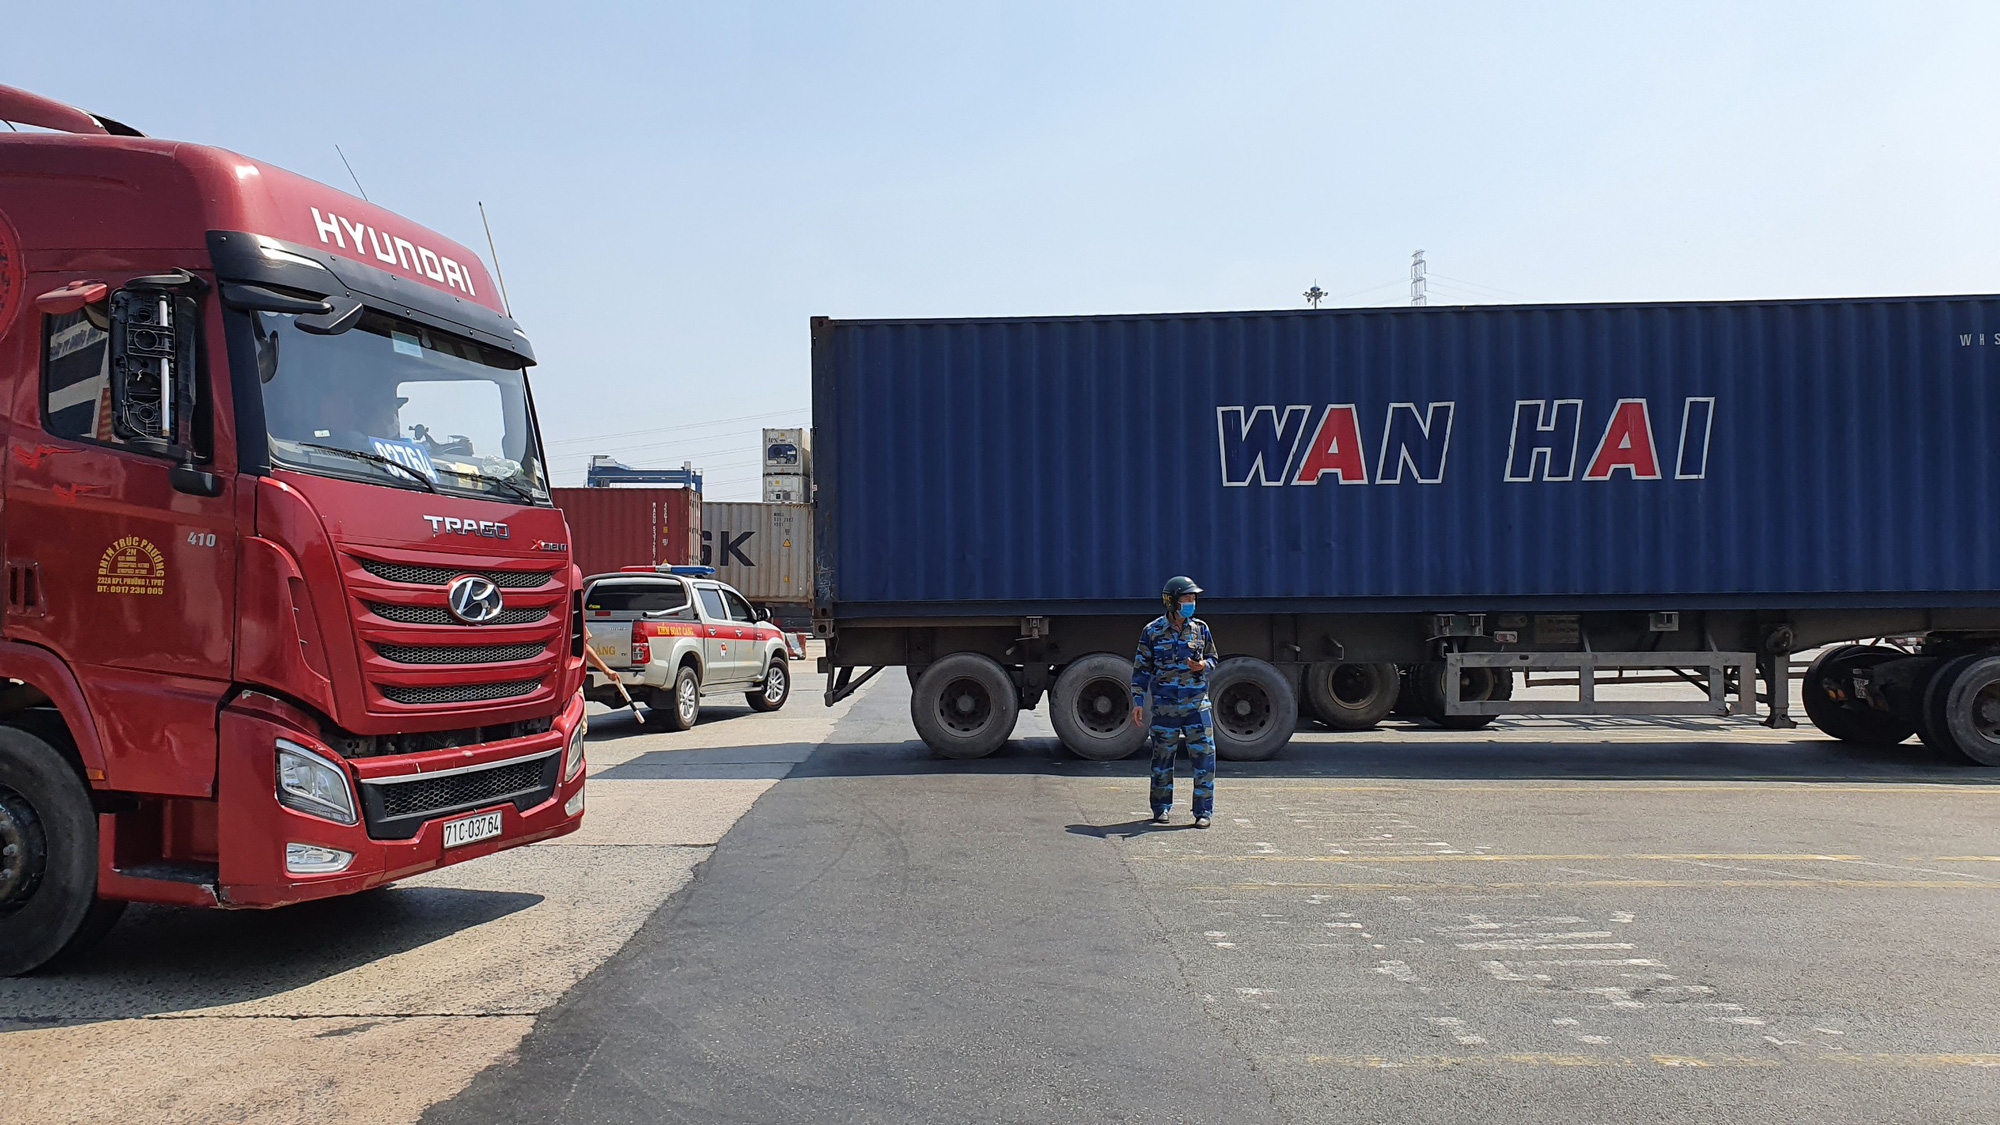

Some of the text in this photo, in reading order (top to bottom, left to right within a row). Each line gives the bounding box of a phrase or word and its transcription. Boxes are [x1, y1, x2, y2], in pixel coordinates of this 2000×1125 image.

[310, 206, 476, 297] HYUNDAI
[1216, 397, 1716, 487] WAN HAI
[187, 531, 216, 547] 410
[423, 514, 510, 540] TRAGO
[98, 547, 115, 575] DNTN
[113, 534, 139, 550] TRÚC
[110, 585, 129, 594] 0917
[129, 586, 146, 594] 238
[147, 587, 163, 595] 005
